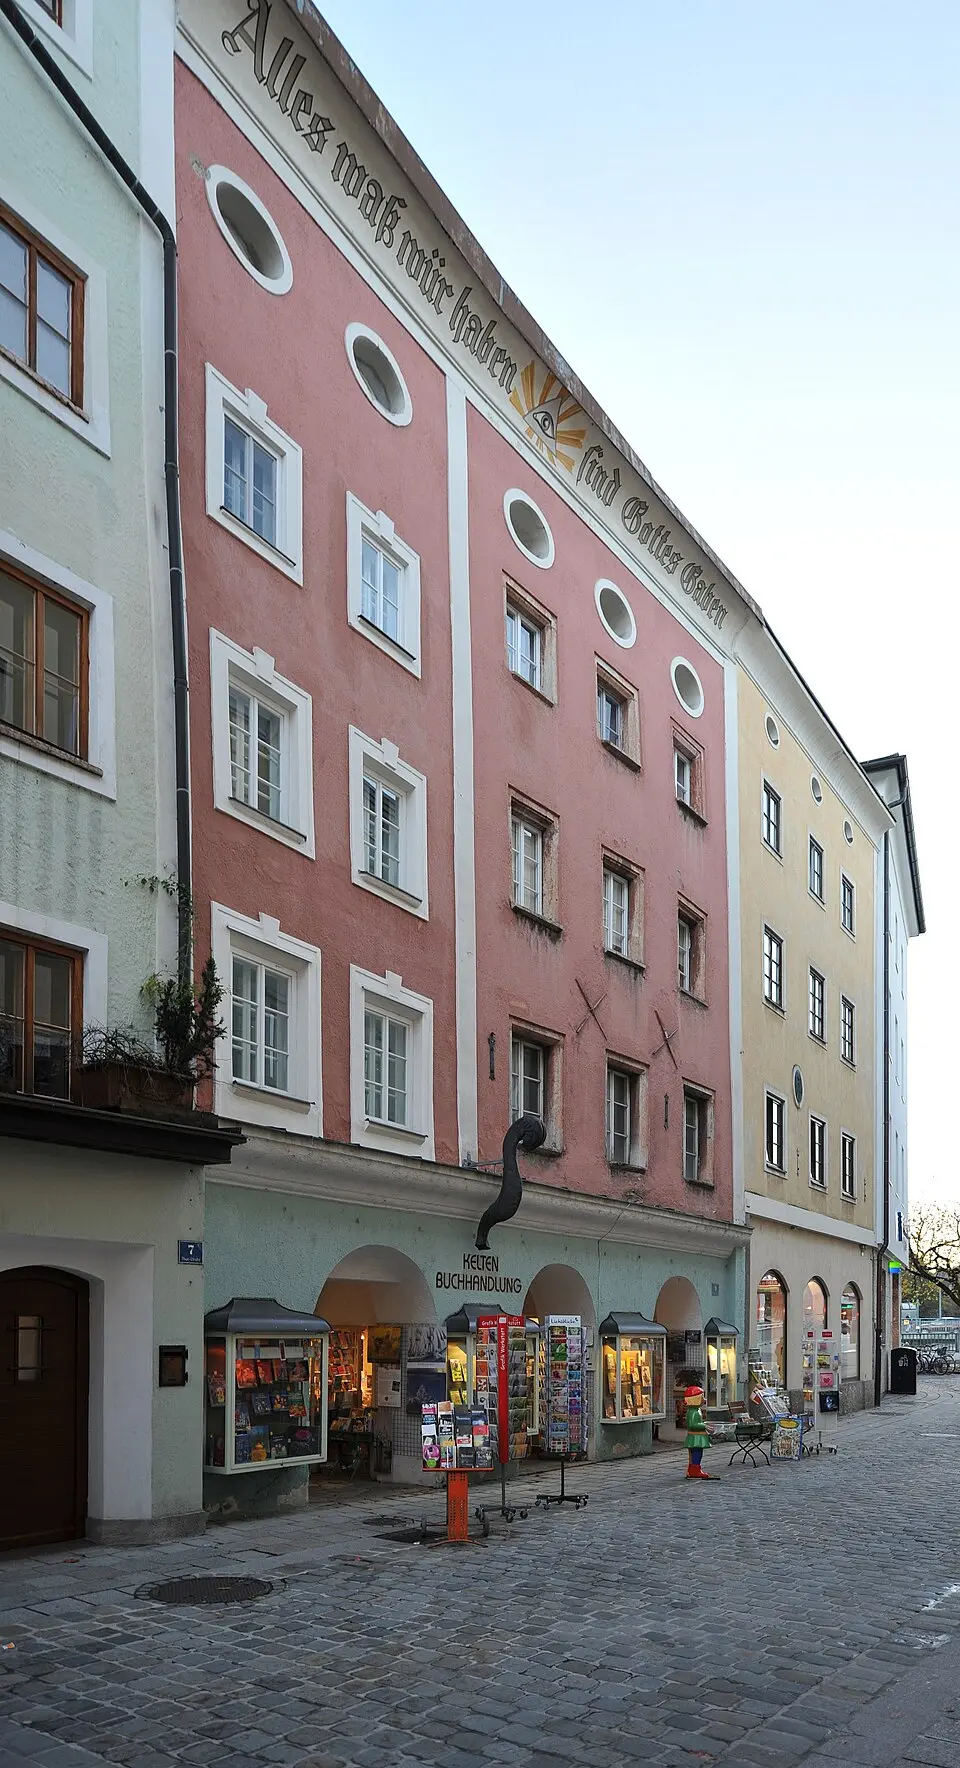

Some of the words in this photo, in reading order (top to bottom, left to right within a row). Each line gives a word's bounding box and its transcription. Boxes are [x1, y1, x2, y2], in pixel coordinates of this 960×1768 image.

[221, 0, 336, 154] Alles
[448, 287, 518, 394] haben
[621, 497, 684, 575] Gottes
[680, 562, 729, 630] Gaben
[188, 1244, 194, 1255] 7
[463, 1253, 499, 1272] KELTEN
[435, 1272, 522, 1294] BUCHHANDLUNG
